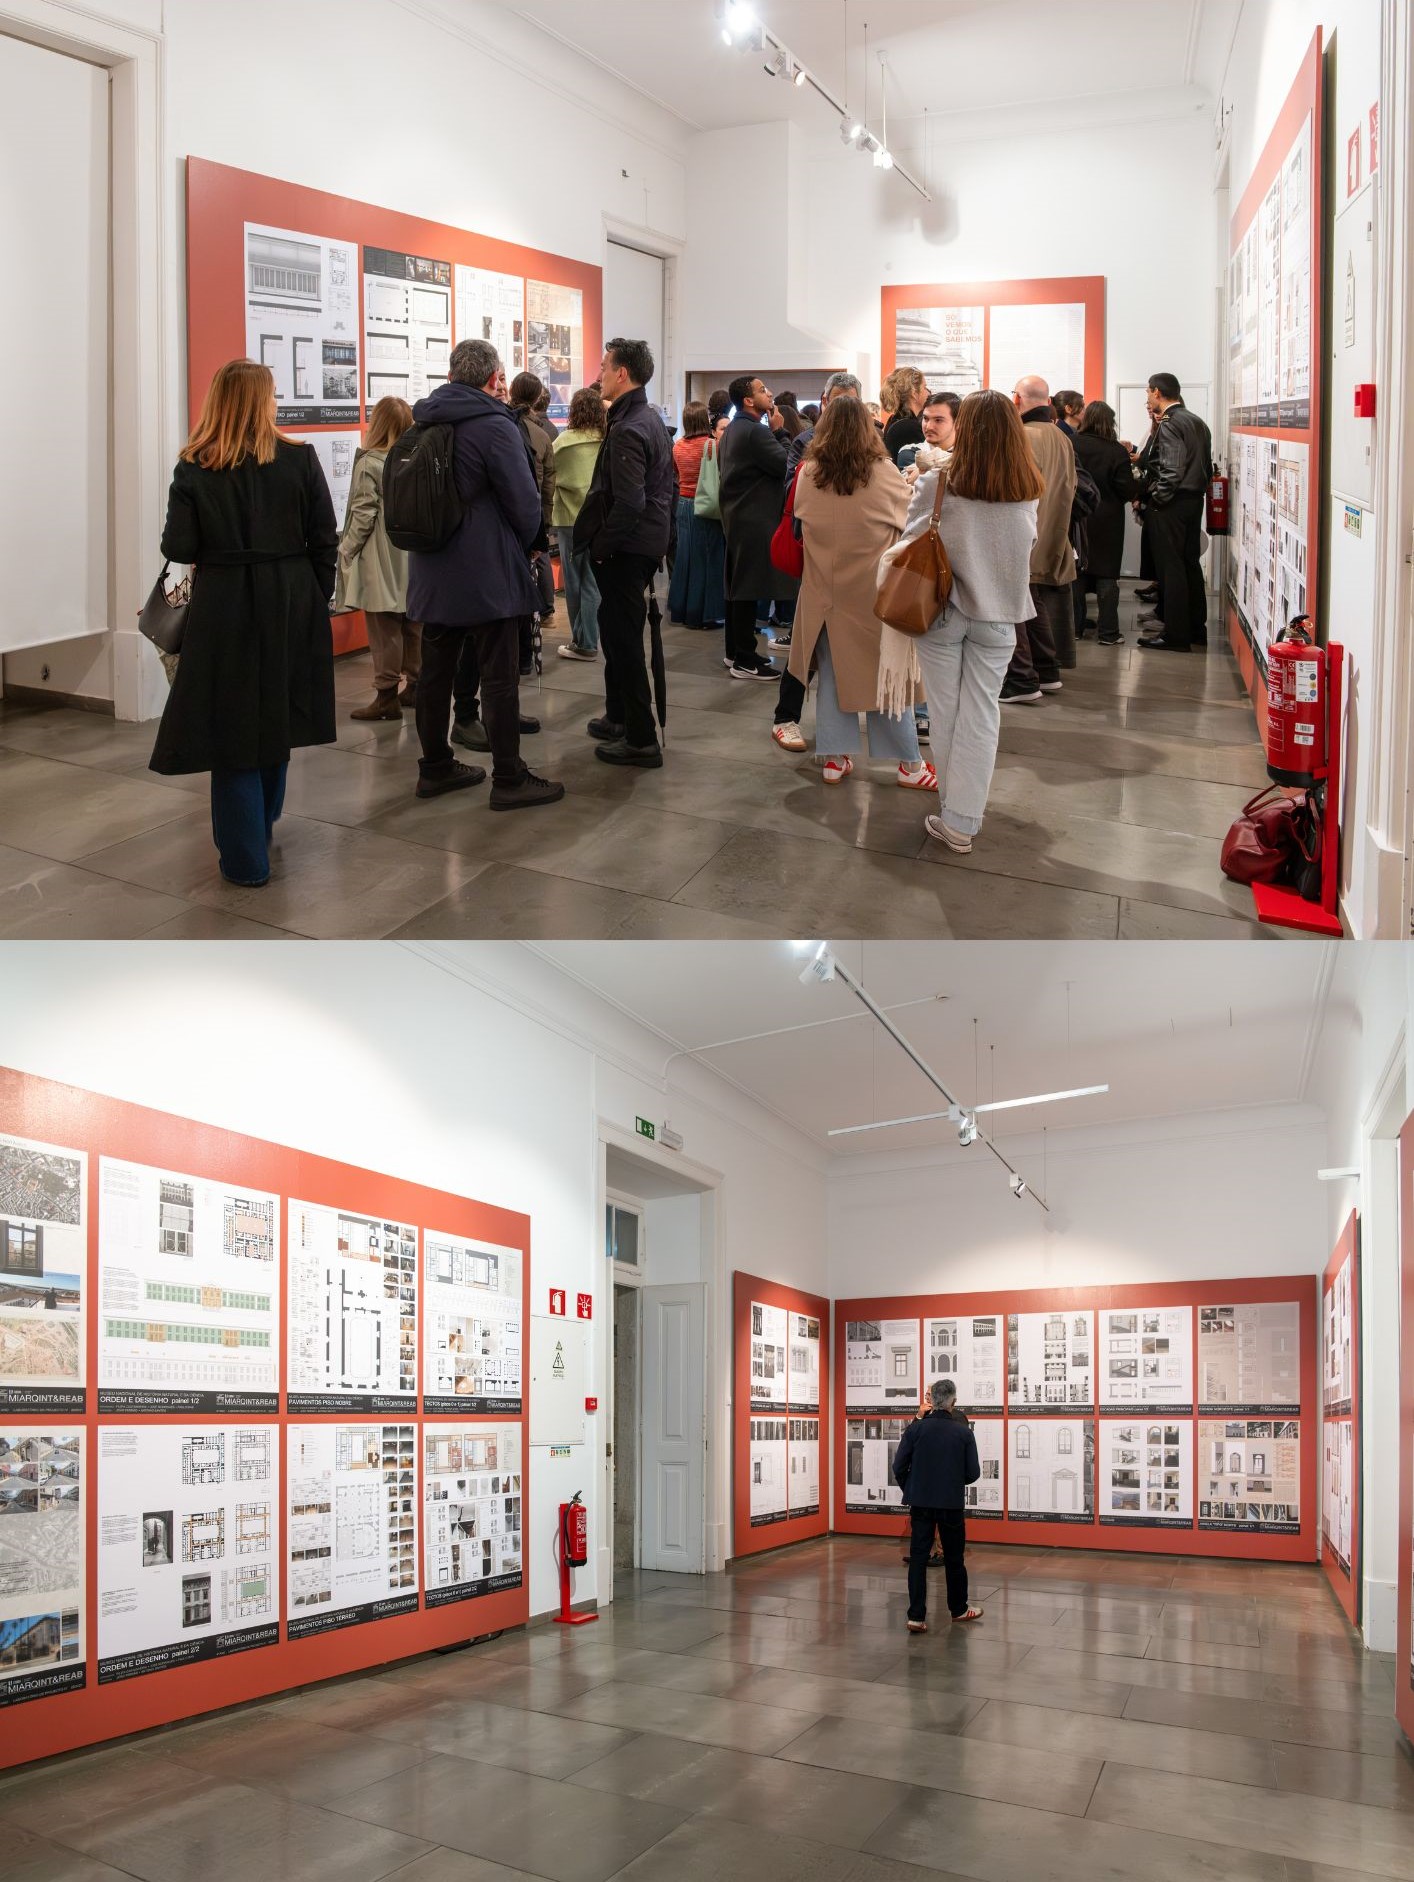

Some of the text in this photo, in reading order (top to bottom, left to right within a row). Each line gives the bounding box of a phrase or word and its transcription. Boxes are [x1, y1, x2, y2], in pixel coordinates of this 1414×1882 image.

[8, 1394, 83, 1402] MIARQINT&REAB
[225, 1629, 277, 1646] MIARQINT&REAB
[100, 1663, 127, 1674] ORDEM
[135, 1653, 169, 1665] DESENHO
[172, 1648, 190, 1658] painel
[8, 1670, 83, 1694] MIARQINT&REAB
